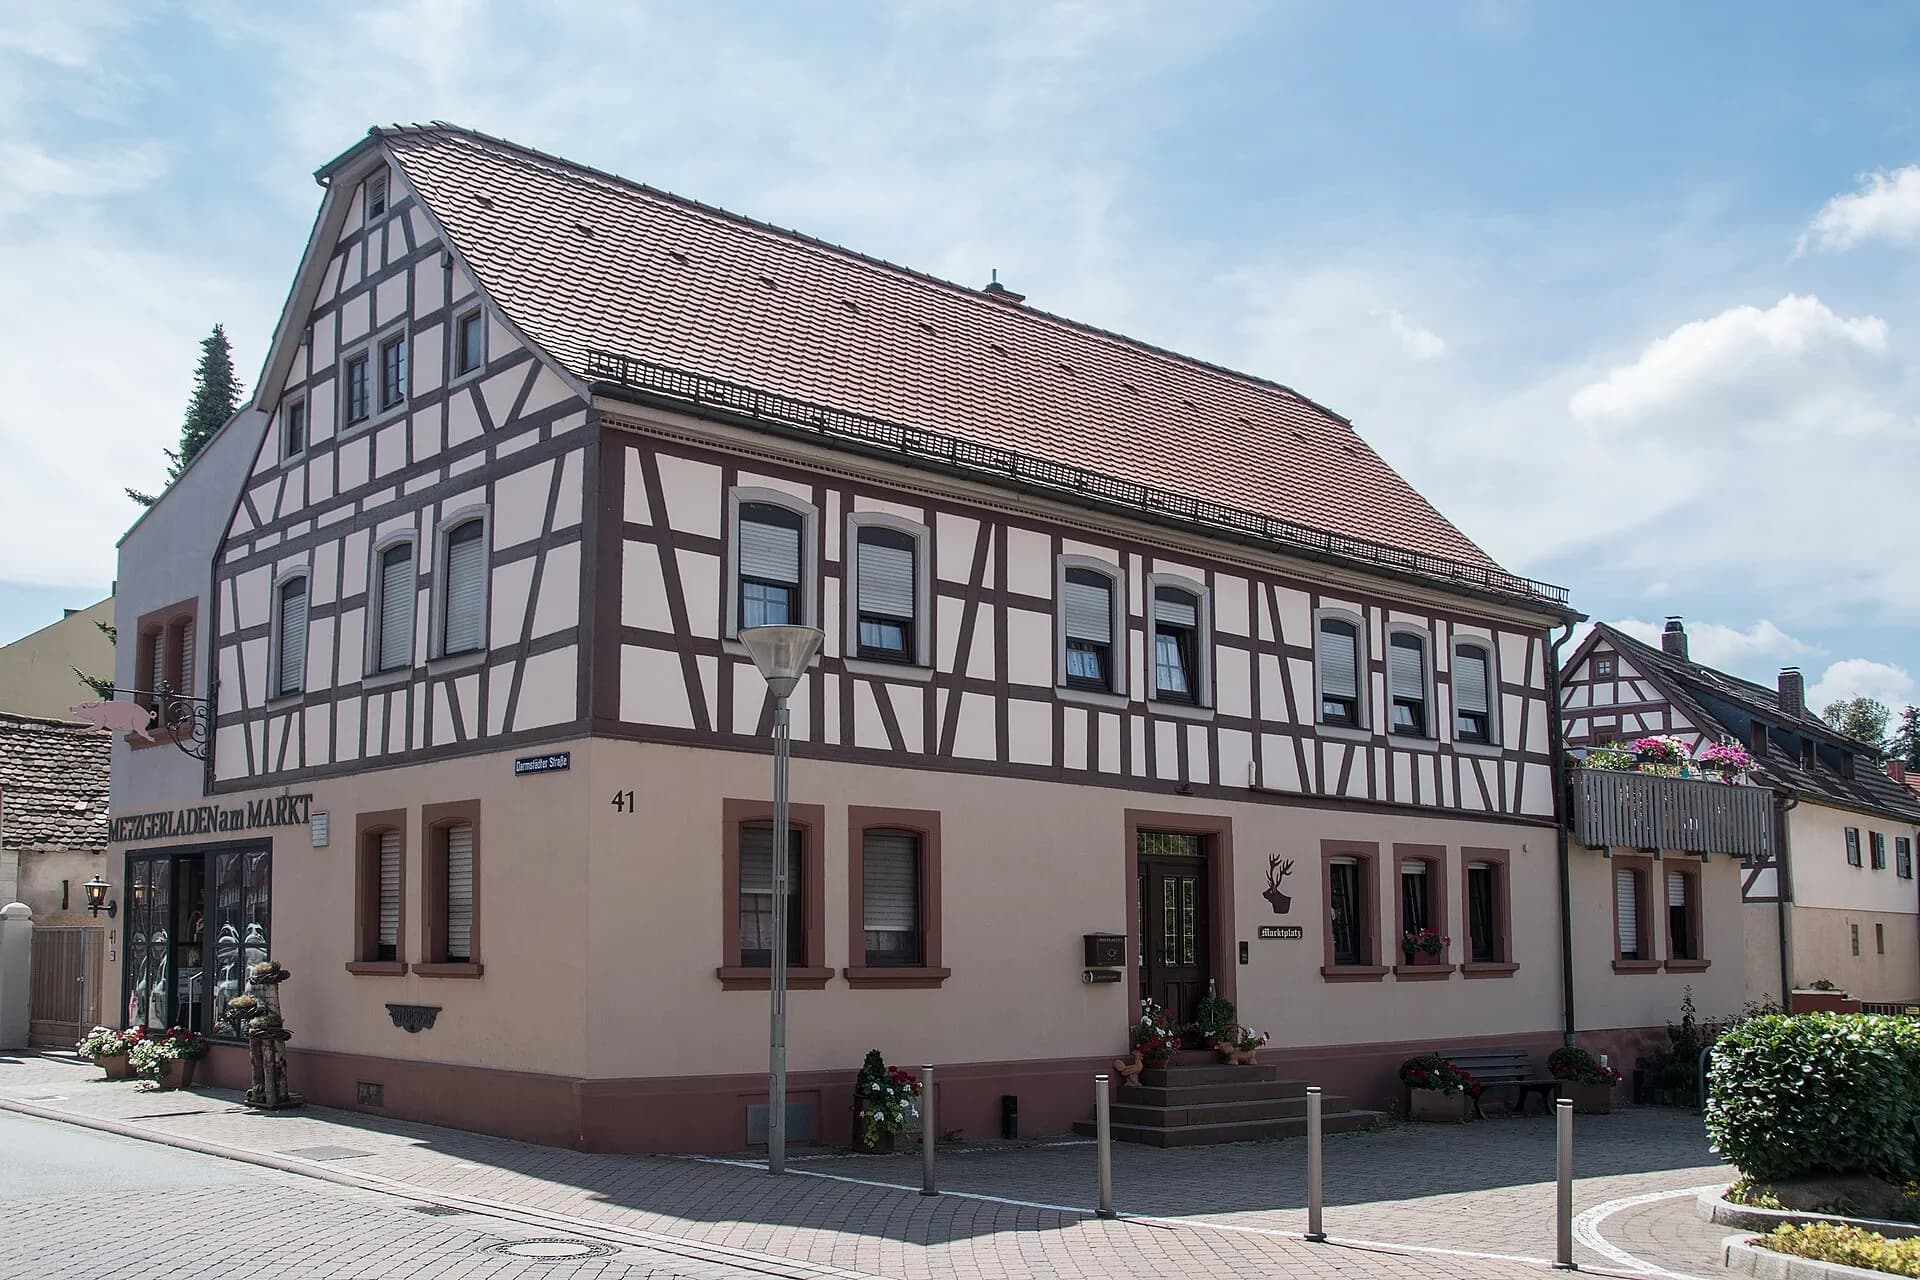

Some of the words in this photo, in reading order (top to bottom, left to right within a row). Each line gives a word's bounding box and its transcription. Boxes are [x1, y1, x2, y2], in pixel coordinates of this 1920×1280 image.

[516, 758, 549, 772] Darmstädter
[549, 755, 568, 769] Straße
[611, 789, 634, 814] 41
[109, 804, 219, 843] METZGERLADEN
[219, 808, 245, 833] am
[246, 793, 313, 829] MARKT
[109, 929, 117, 945] 41
[1261, 928, 1302, 939] Marktplatz
